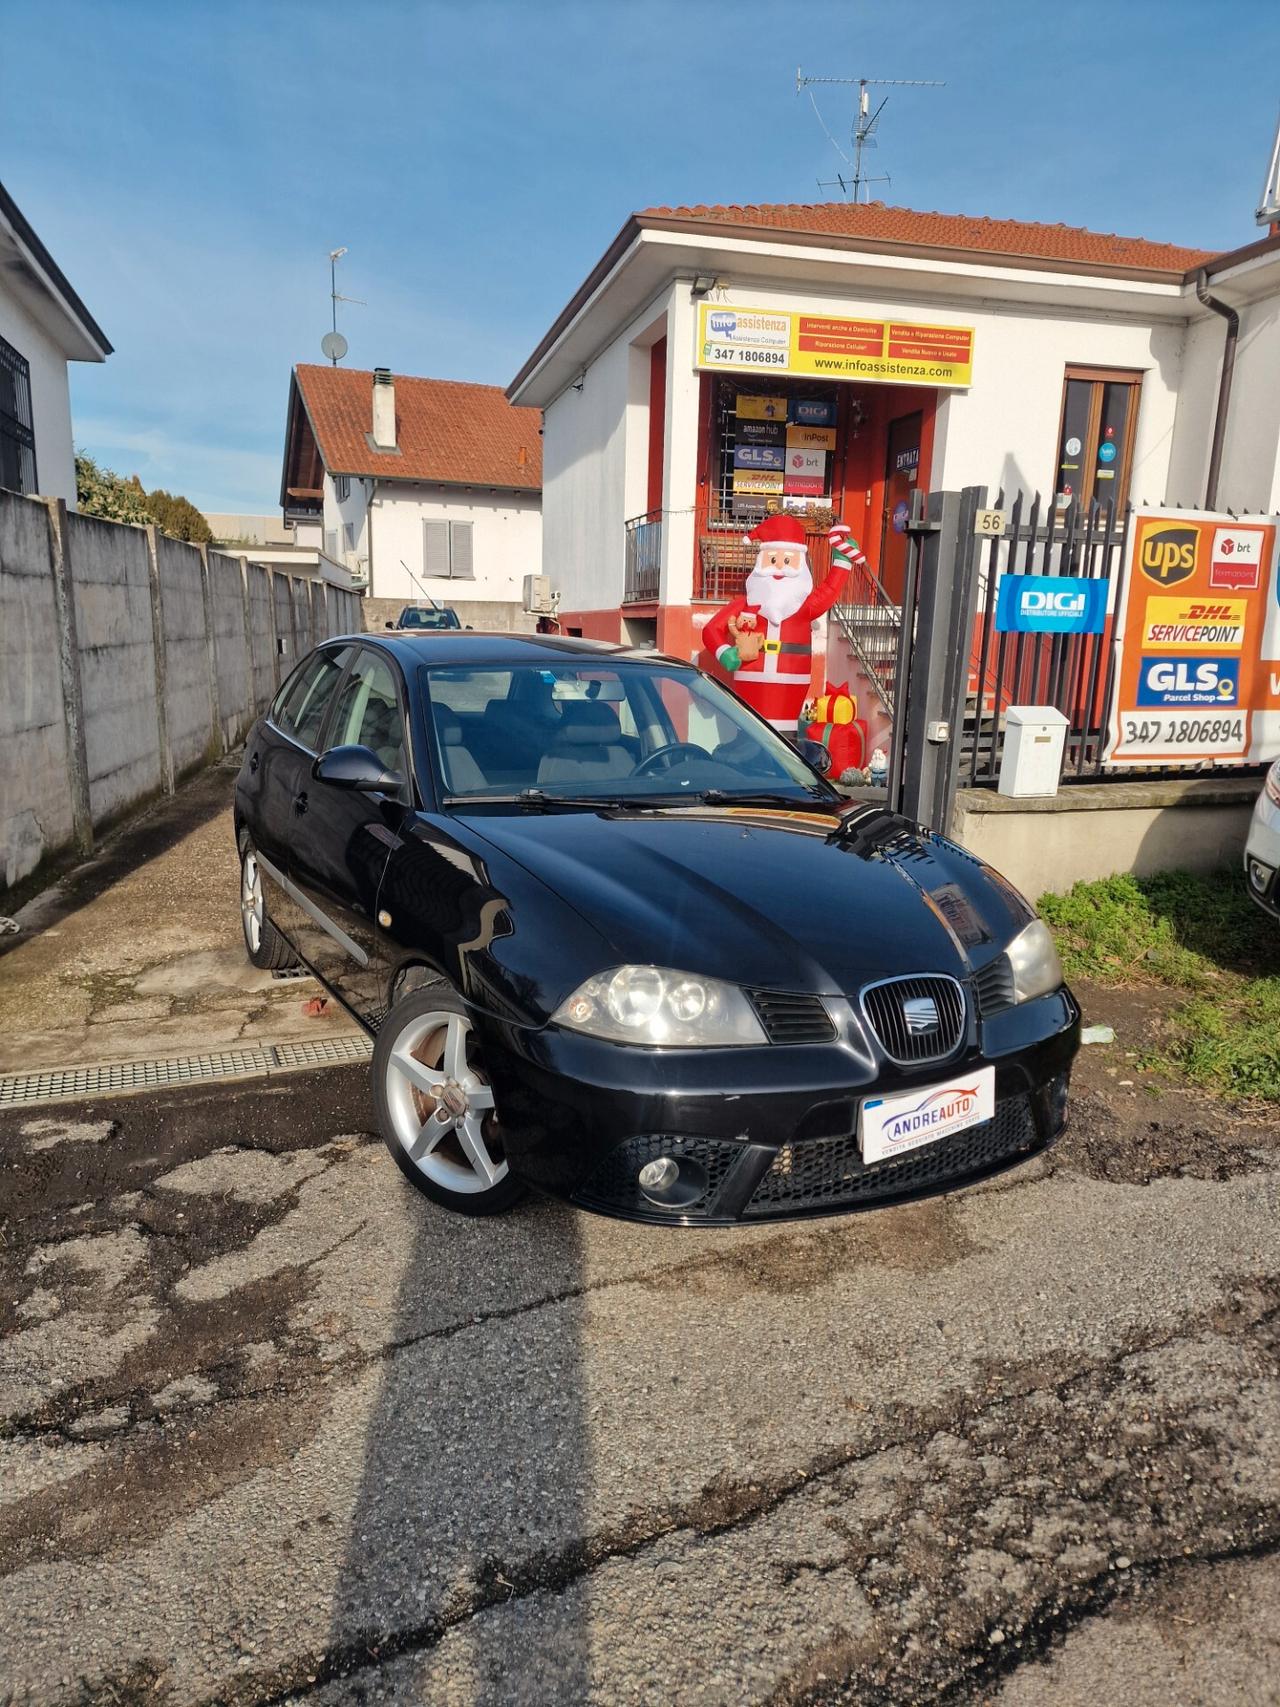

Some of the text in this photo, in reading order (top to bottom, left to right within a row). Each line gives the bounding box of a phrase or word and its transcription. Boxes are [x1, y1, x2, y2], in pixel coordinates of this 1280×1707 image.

[945, 333, 970, 342] Computer
[714, 348, 785, 364] 347 1806894
[815, 359, 952, 377] www.infoassistenza.com
[798, 406, 828, 417] DIGI
[743, 424, 779, 435] amazon hub
[738, 448, 774, 462] GLS
[806, 456, 818, 467] brt
[896, 449, 919, 469] ENTRATA
[982, 514, 1002, 530] 56
[1236, 543, 1251, 553] brt
[1144, 541, 1194, 578] ups
[1021, 591, 1085, 611] DIGI
[1187, 605, 1233, 620] DHL
[1147, 624, 1240, 643] SERVICEPOINT
[1146, 662, 1220, 692] GLS
[1163, 693, 1216, 704] Parcel Shop
[1125, 719, 1243, 744] 347 1806894
[893, 1097, 970, 1138] ANDREAUTO
